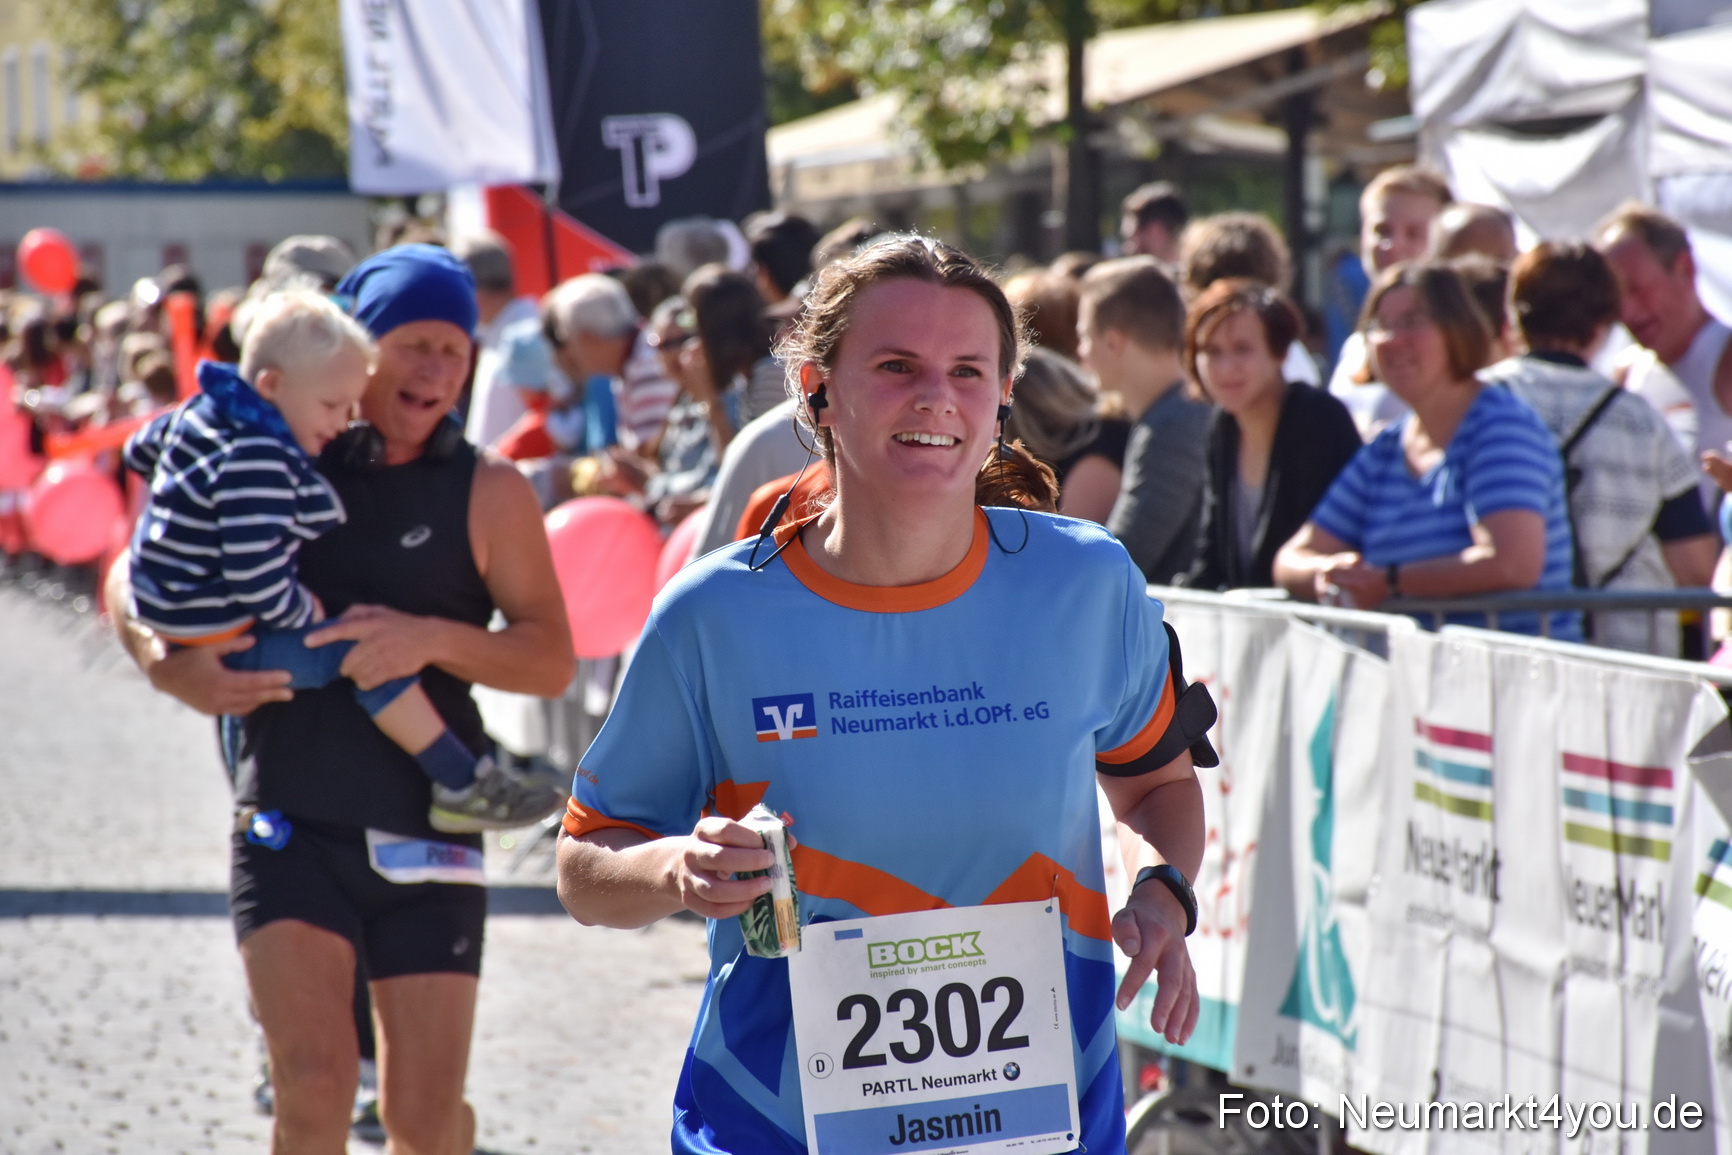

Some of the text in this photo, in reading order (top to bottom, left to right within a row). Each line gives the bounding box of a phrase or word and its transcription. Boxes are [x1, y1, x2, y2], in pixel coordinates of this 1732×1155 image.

[829, 682, 986, 709] Raiffeisenbank
[831, 702, 1050, 735] Neumarkt i.d.OPf. eG
[867, 931, 985, 968] BOCK
[870, 958, 987, 979] inspired by smart concepts
[836, 976, 1030, 1070] 2302
[815, 1059, 826, 1073] D
[862, 1078, 918, 1096] PARTL
[921, 1068, 998, 1090] Neumarkt
[889, 1104, 1002, 1146] Jasmin
